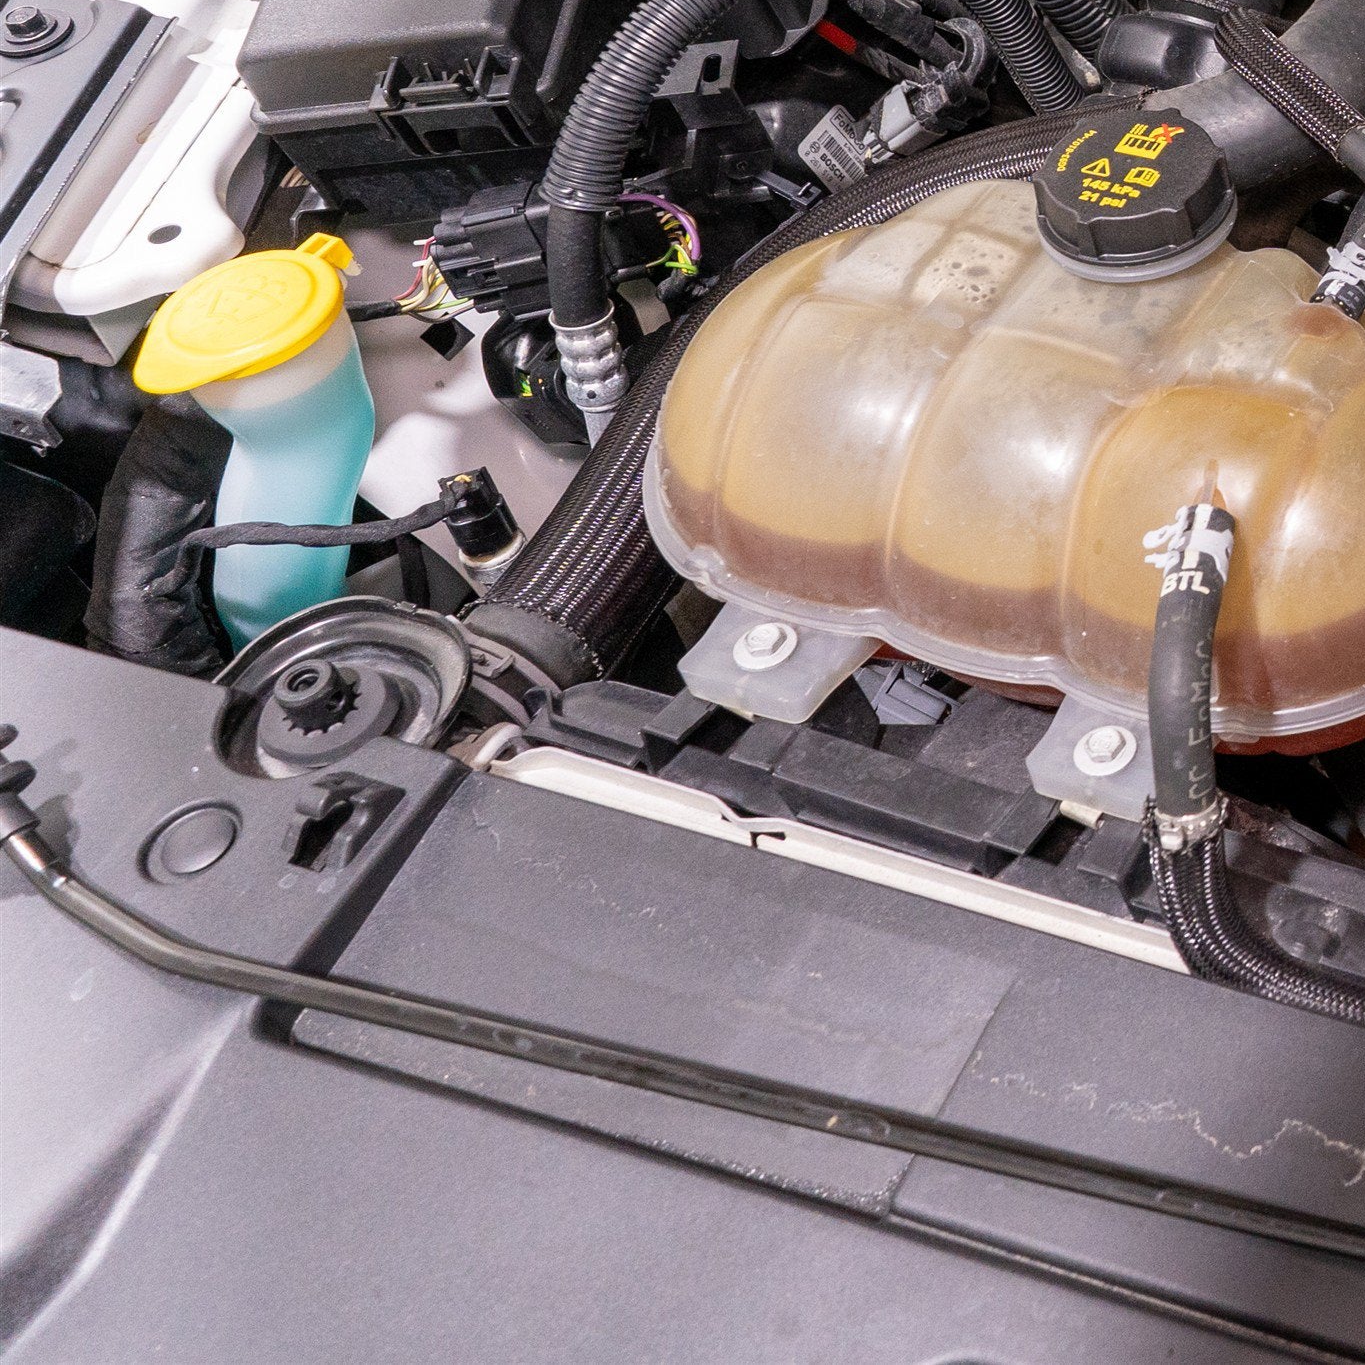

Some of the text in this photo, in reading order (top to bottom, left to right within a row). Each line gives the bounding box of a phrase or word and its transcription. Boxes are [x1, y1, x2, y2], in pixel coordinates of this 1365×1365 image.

[819, 153, 846, 182] BOSCH
[1078, 190, 1127, 208] 21 psi
[1081, 177, 1141, 198] 145 kPa
[1160, 570, 1211, 598] BTL
